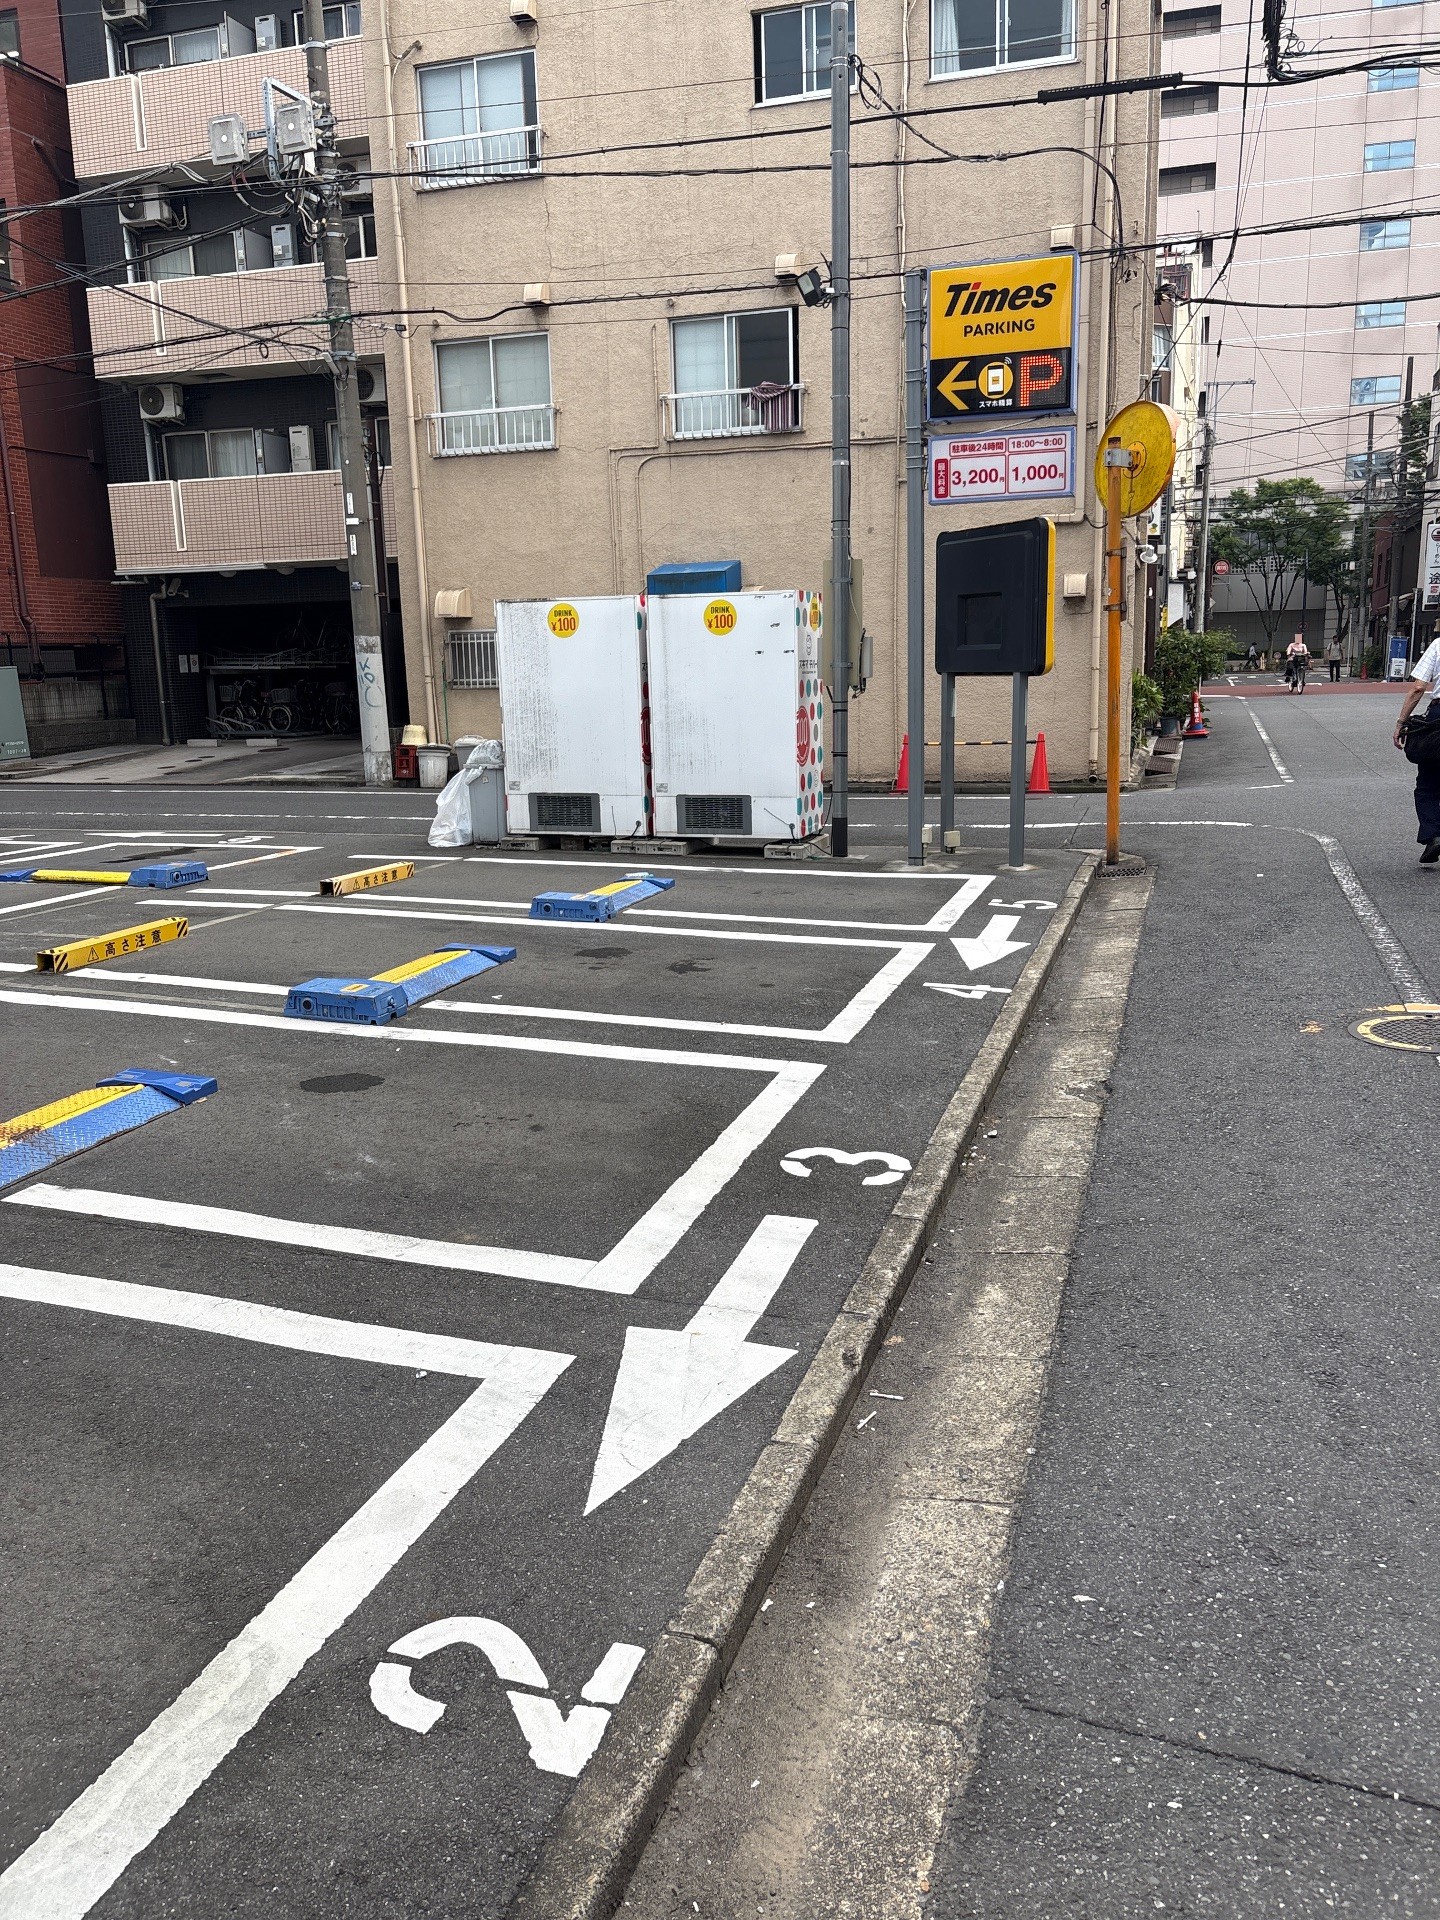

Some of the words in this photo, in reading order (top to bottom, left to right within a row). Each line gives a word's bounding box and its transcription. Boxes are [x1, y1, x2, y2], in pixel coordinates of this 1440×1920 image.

[944, 282, 1057, 317] Times
[963, 318, 1035, 337] PARKING
[1020, 354, 1063, 407] P
[951, 440, 1004, 454] 駐車後24時間
[553, 609, 573, 618] DRINK
[710, 605, 731, 615] DRINK
[551, 616, 577, 632] ¥100
[707, 613, 734, 630] ¥100
[363, 869, 398, 888] 高さ注意
[104, 929, 162, 957] 高さ注意
[922, 981, 1013, 1000] 4
[780, 1147, 913, 1186] 3
[369, 1616, 646, 1778] 2
